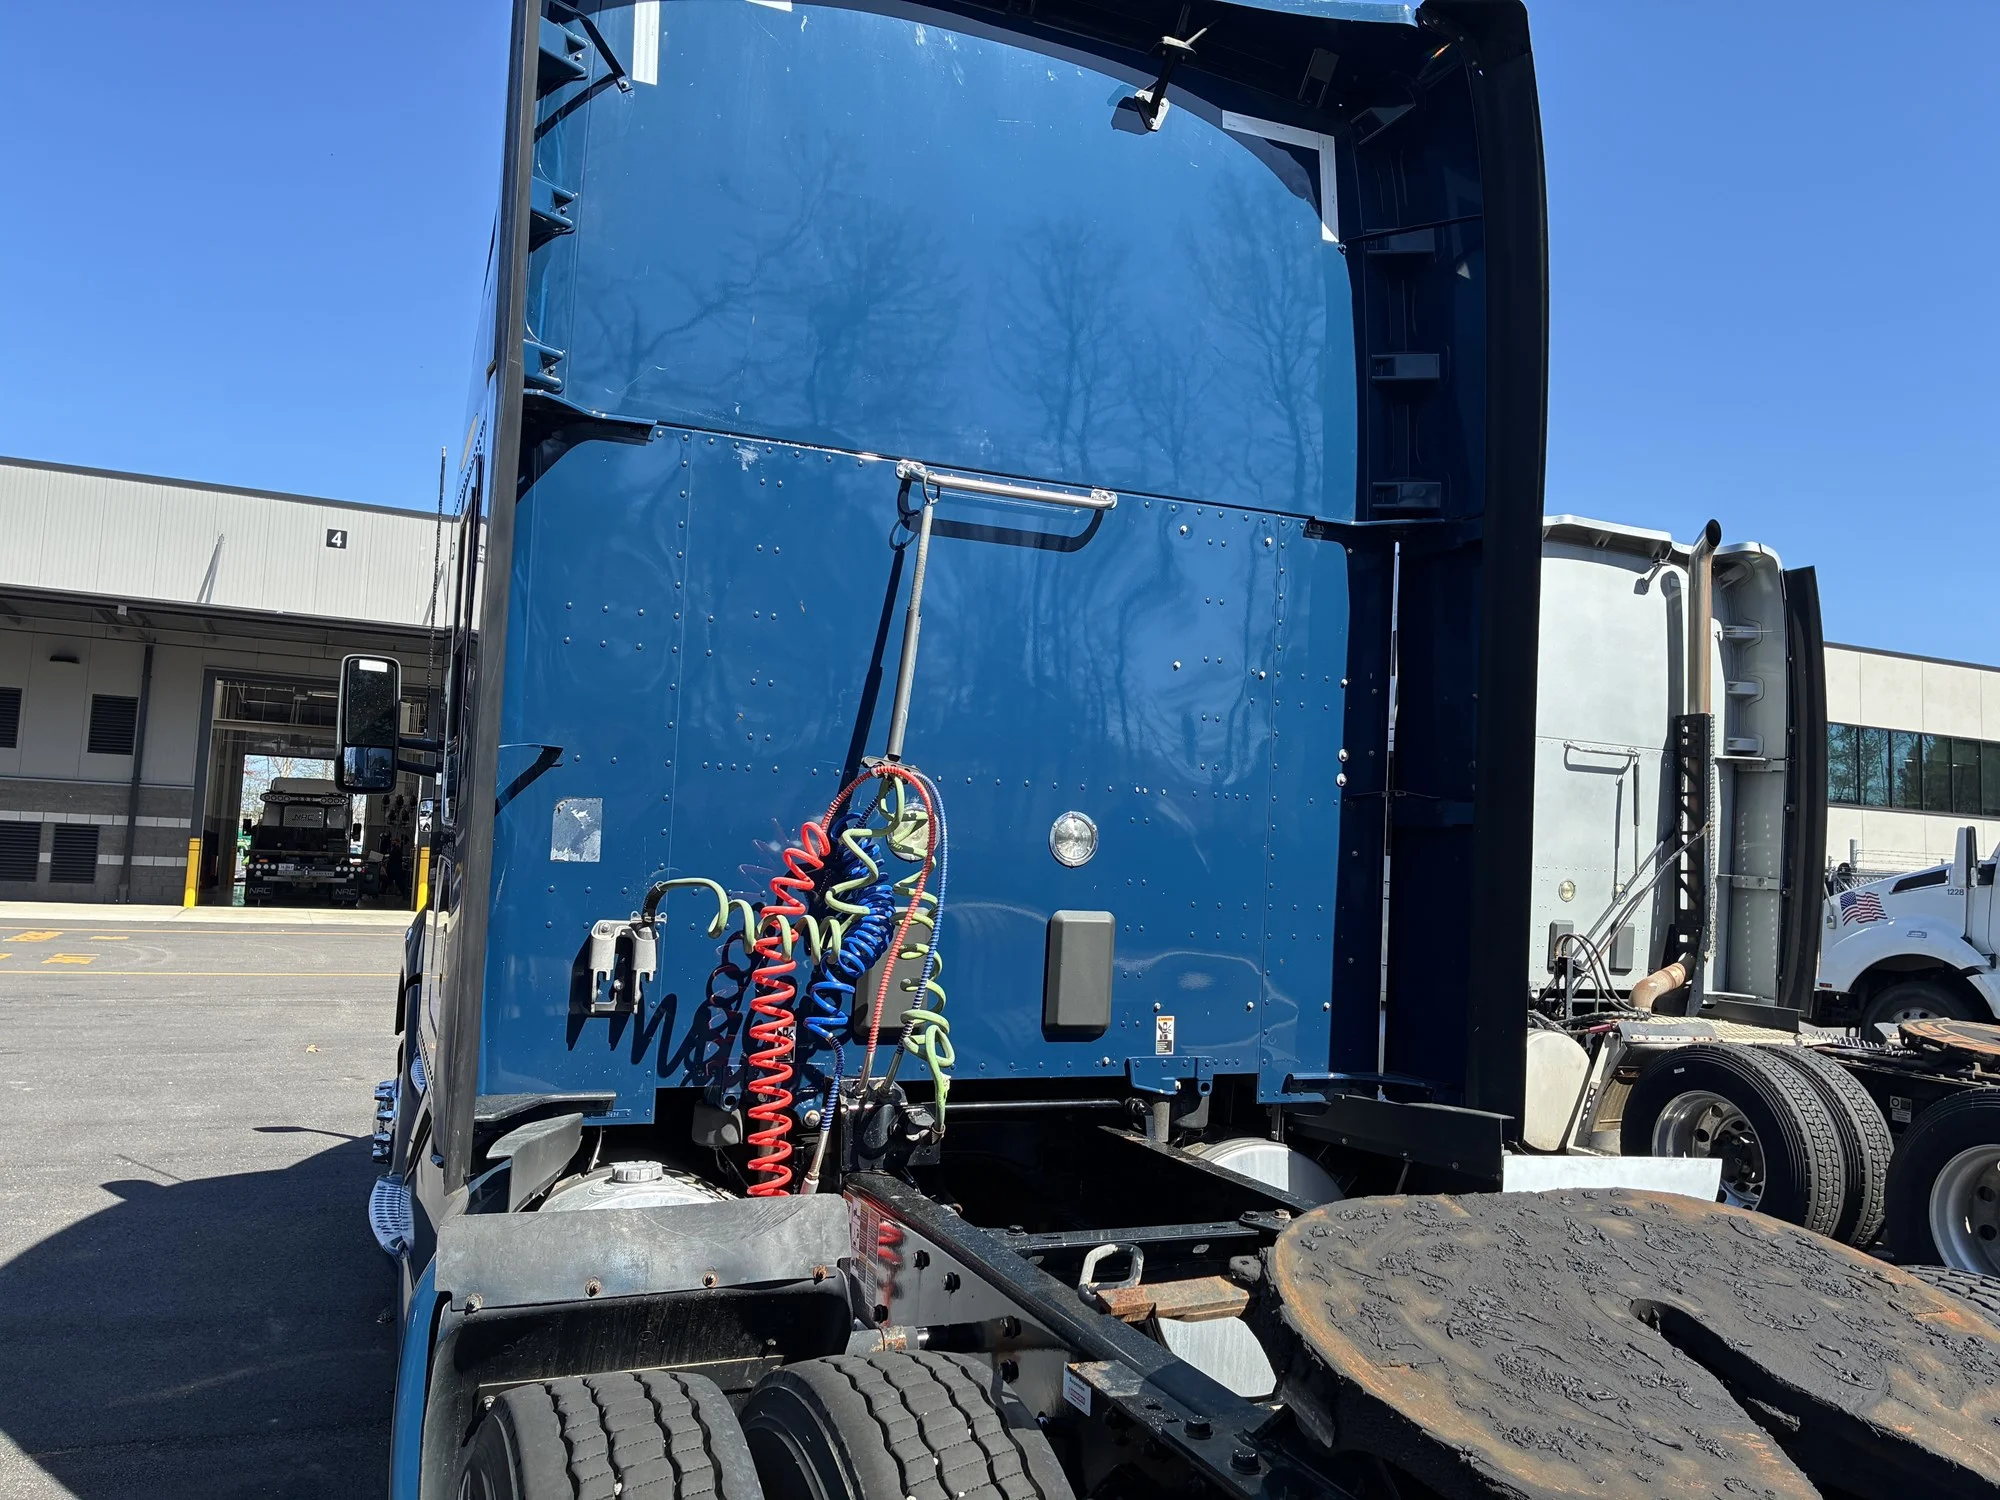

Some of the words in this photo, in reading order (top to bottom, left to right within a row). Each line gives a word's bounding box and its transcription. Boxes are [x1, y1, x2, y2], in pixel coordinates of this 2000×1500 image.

[331, 531, 342, 547] 4
[295, 813, 315, 821] NRC
[248, 887, 271, 895] NRC
[335, 888, 357, 896] NRC
